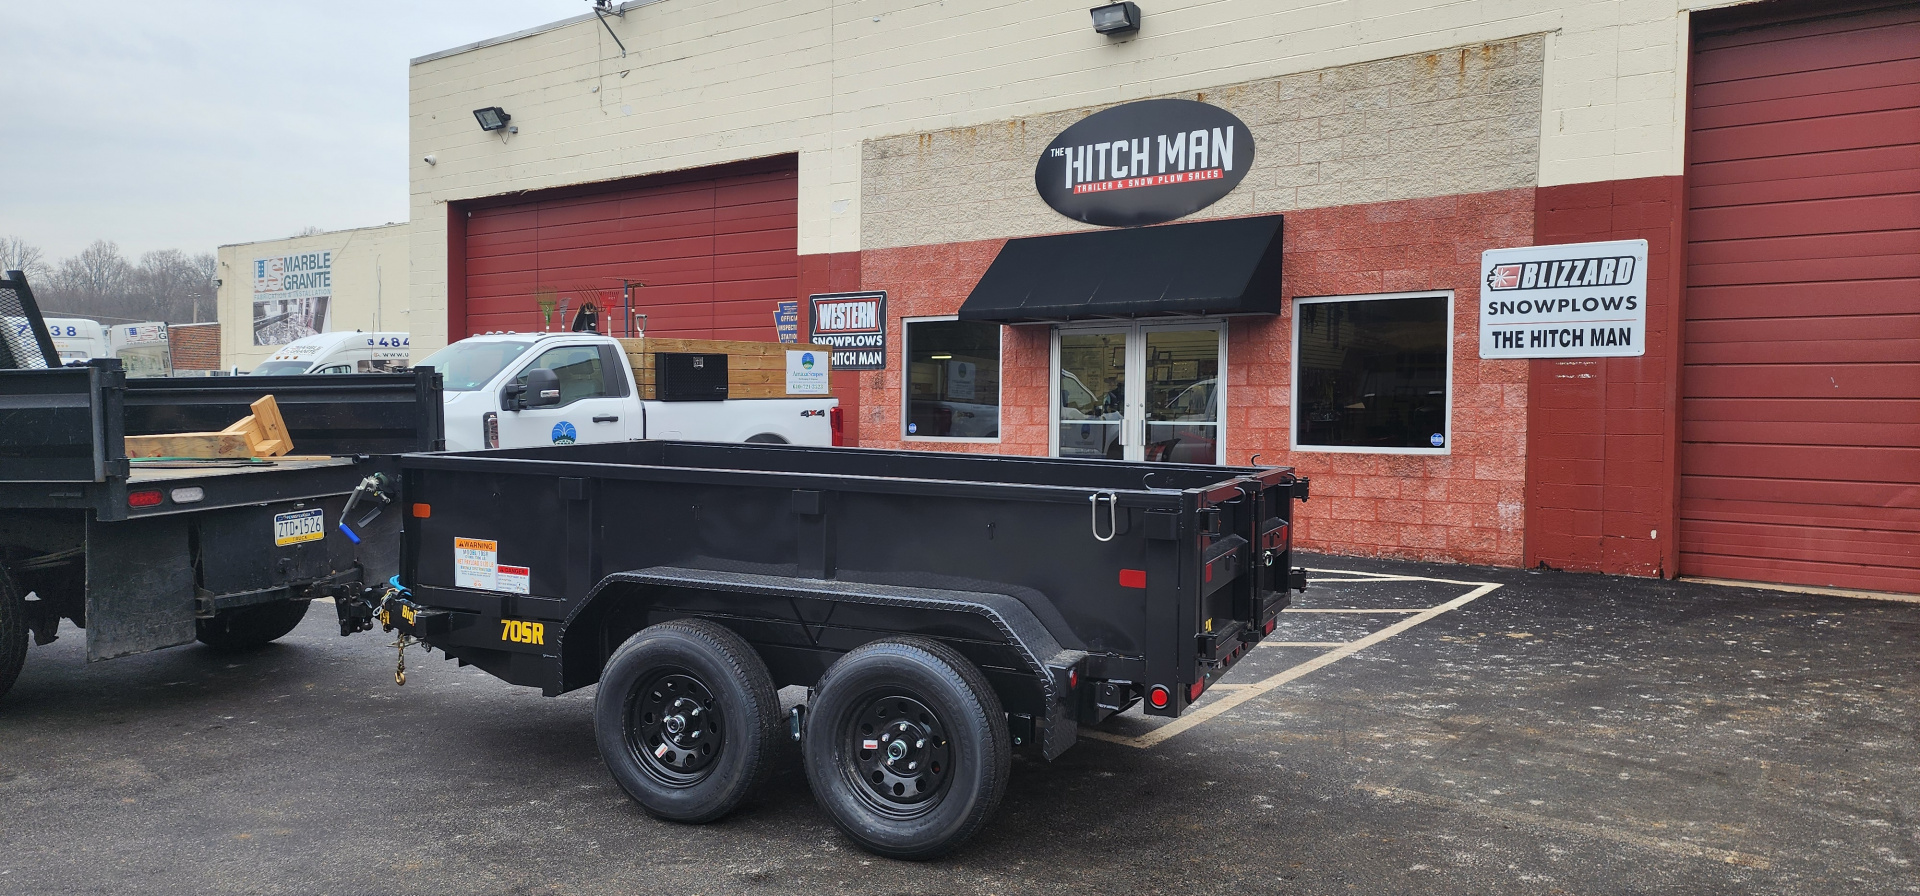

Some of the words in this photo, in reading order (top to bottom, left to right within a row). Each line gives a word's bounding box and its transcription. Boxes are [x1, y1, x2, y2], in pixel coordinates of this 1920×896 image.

[1050, 147, 1065, 158] THE
[1065, 136, 1150, 189] HITCH
[1157, 125, 1234, 174] MAN
[1077, 181, 1113, 193] TRAILER
[1117, 180, 1123, 189] &
[1128, 177, 1154, 187] SNOW
[1158, 173, 1183, 184] PLOW
[1188, 169, 1219, 181] SALES
[284, 251, 331, 273] MARBLE
[1521, 256, 1635, 289] BLIZZARD
[284, 270, 331, 291] GRANITE
[819, 301, 876, 330] WESTERN
[1488, 295, 1637, 316] SNOWPLOWS
[812, 335, 883, 347] SNOWPLOWS
[1492, 330, 1525, 349] THE
[1530, 328, 1584, 348] HITCH
[1590, 327, 1632, 347] MAN
[832, 352, 856, 366] HITCH
[859, 351, 882, 365] MAN
[463, 541, 493, 550] WARNING
[501, 619, 544, 646] 70SR
